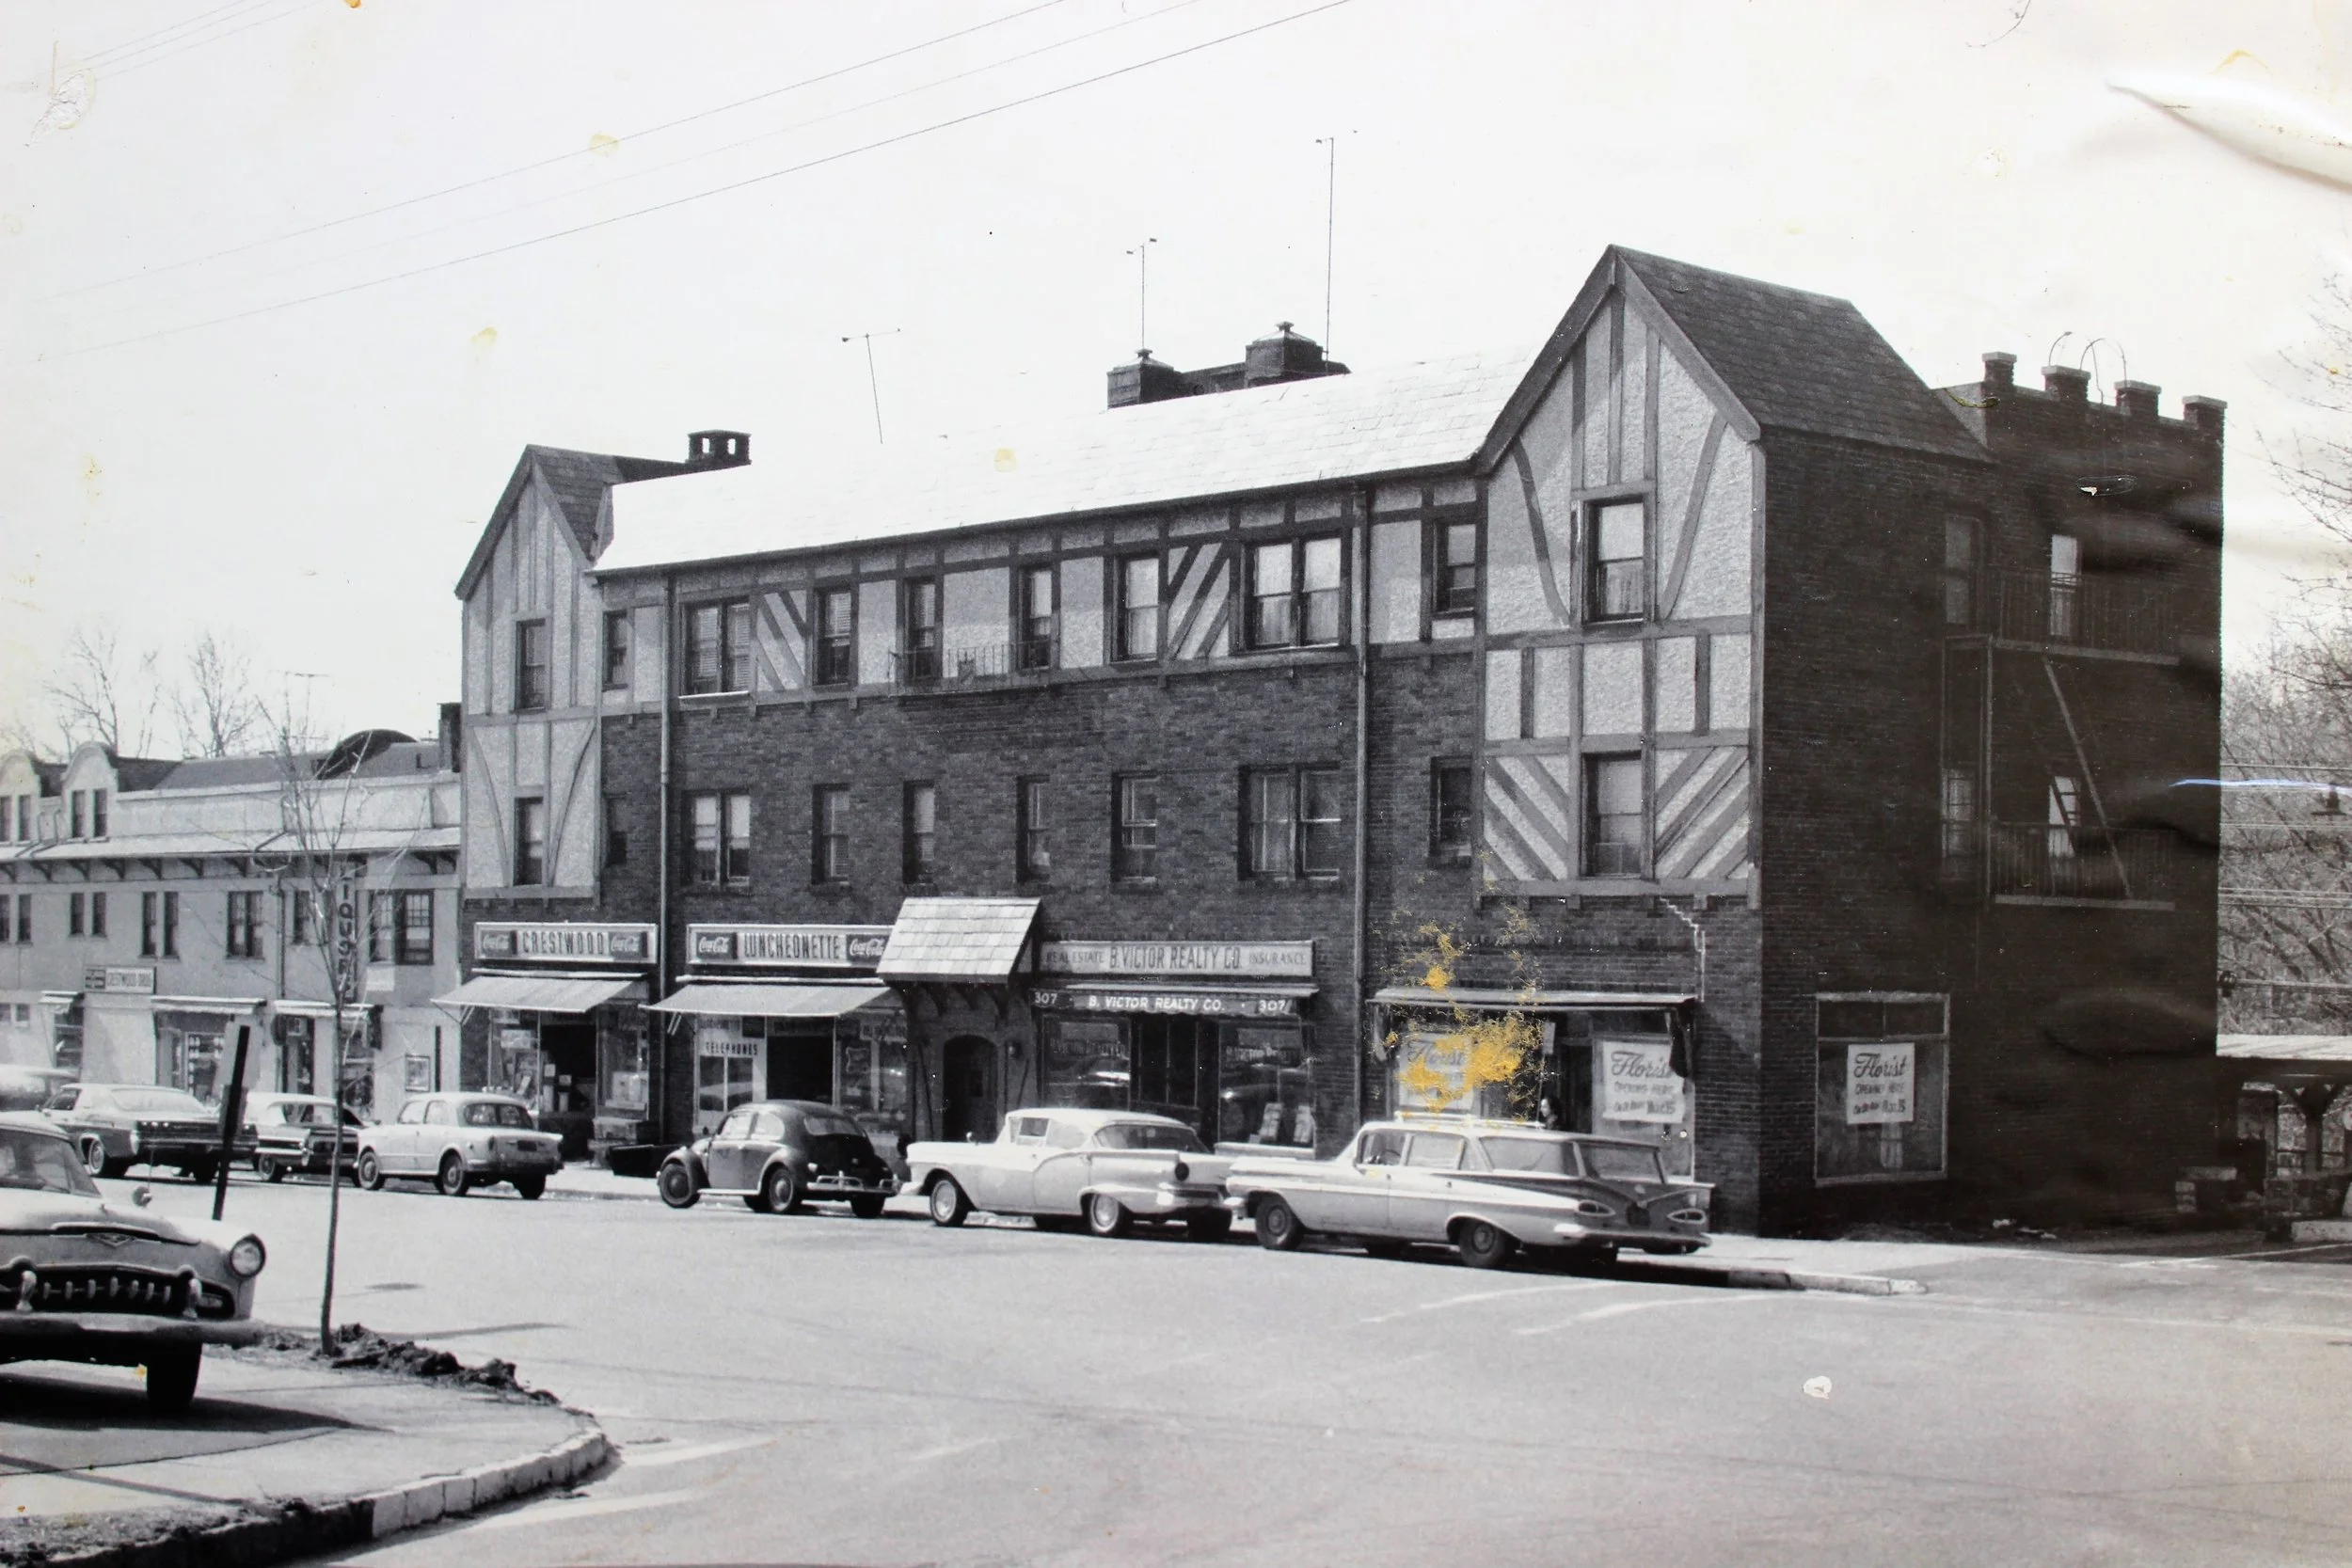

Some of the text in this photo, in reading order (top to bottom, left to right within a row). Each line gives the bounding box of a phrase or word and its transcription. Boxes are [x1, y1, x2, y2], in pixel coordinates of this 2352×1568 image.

[522, 931, 604, 955] CRESTWOOD
[743, 933, 841, 959] LUNCHEONETTE
[1045, 951, 1105, 964] REAL ESTATE
[1169, 946, 1219, 969] REALTY
[1248, 951, 1307, 965] INSURANCE
[1035, 992, 1058, 1005] 307
[1089, 995, 1100, 1007] B.
[1155, 997, 1199, 1010] REALTY
[1203, 998, 1225, 1011] CO.
[1259, 999, 1286, 1012] 307
[706, 1041, 758, 1056] TELEPHONES
[1853, 1053, 1908, 1079] Florist
